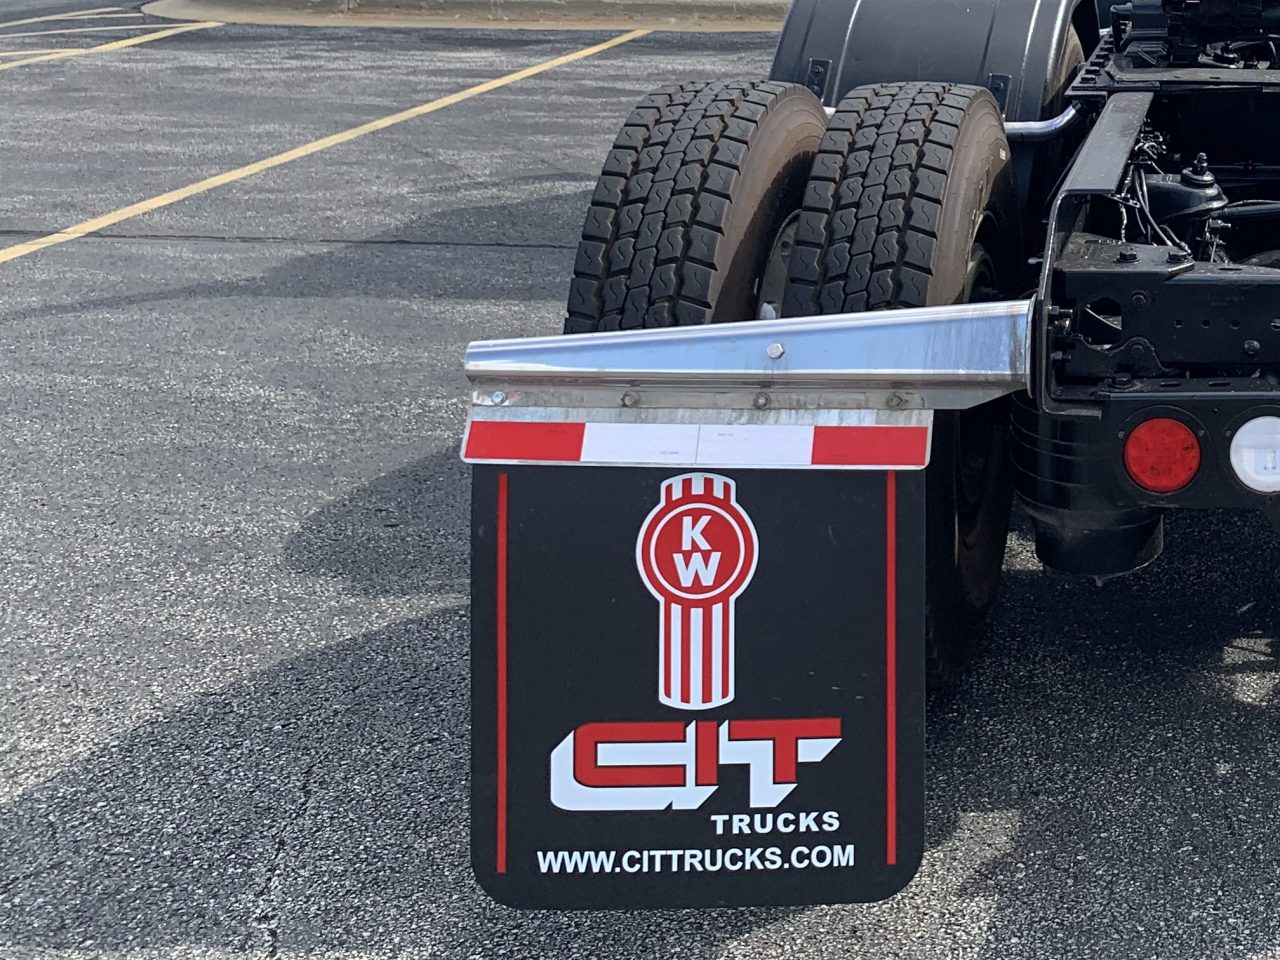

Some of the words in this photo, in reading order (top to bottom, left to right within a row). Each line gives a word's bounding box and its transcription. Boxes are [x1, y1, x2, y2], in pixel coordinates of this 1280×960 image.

[550, 717, 843, 811] CIT
[710, 810, 841, 835] TRUCKS
[536, 844, 855, 874] WWW.CITTRUCKS.COM
